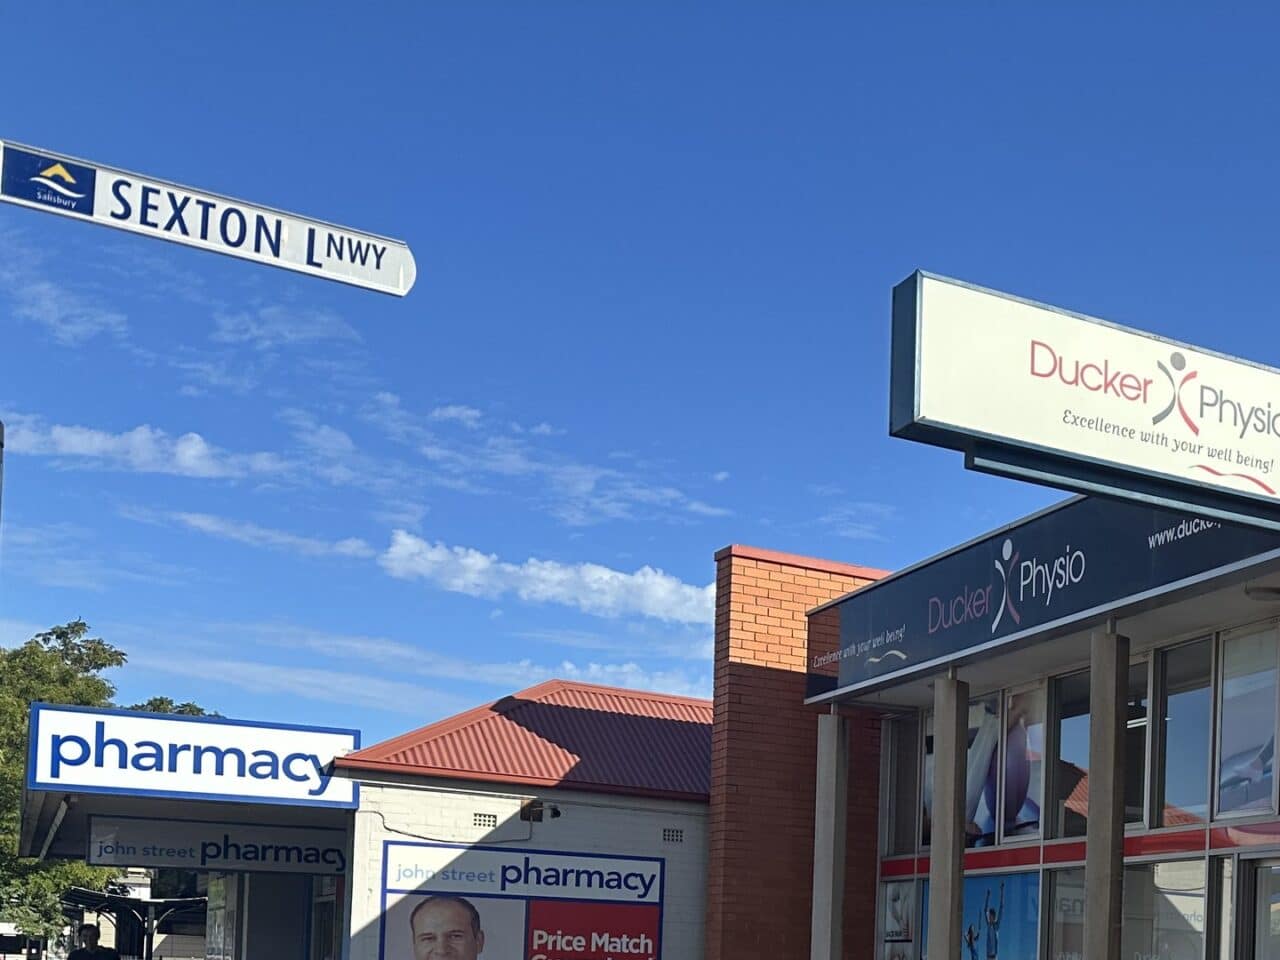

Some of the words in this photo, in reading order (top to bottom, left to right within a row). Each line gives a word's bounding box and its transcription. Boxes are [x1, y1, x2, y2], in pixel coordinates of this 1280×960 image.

[36, 190, 77, 209] Salisbury
[110, 179, 282, 259] SEXTON
[1030, 340, 1153, 403] Ducker
[1062, 409, 1136, 439] Excellence
[1140, 430, 1169, 448] with
[1172, 438, 1204, 455] your
[1207, 446, 1232, 462] well
[1236, 452, 1275, 474] being!
[927, 585, 992, 634] Ducker
[1019, 545, 1086, 606] Physio
[50, 720, 335, 796] pharmacy
[97, 839, 137, 858] john
[142, 844, 196, 859] street
[200, 834, 348, 873] pharmacy
[397, 863, 436, 882] john
[441, 868, 496, 883] street
[500, 857, 657, 898] pharmacy
[532, 930, 586, 952] Price
[591, 932, 654, 955] Match
